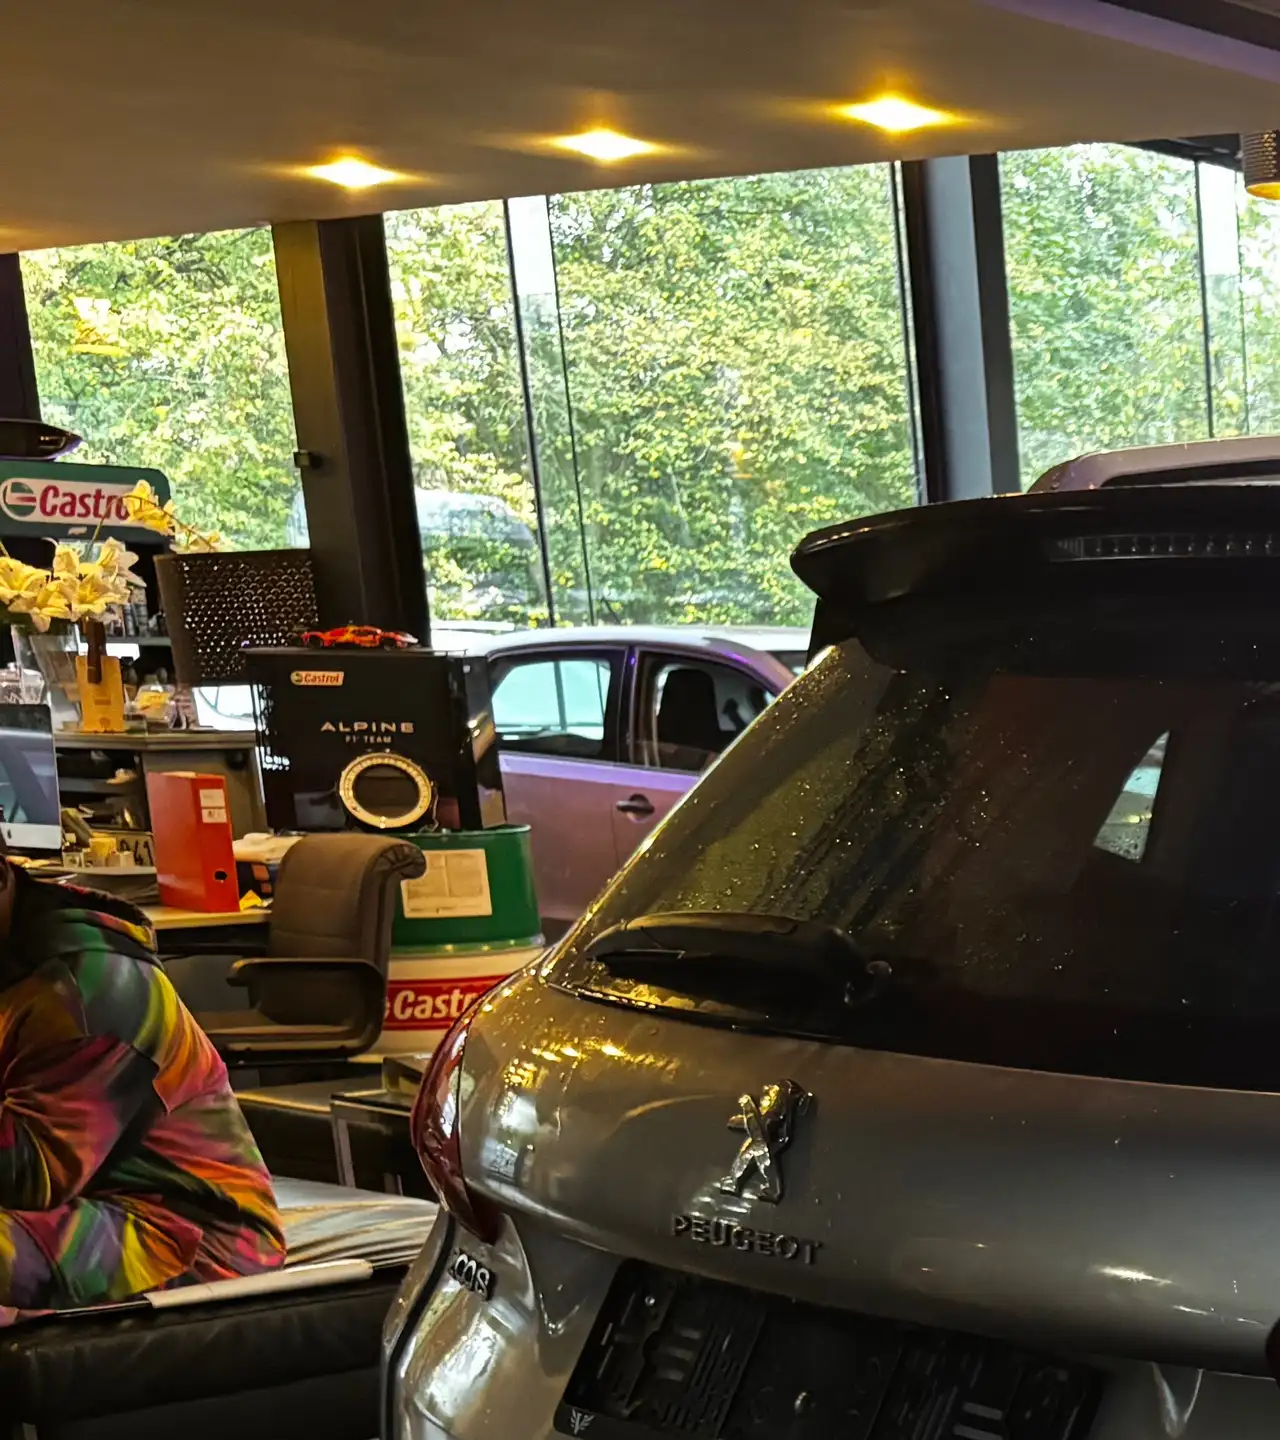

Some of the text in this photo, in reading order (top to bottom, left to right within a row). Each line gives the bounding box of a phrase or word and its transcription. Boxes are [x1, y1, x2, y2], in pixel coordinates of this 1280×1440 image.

[39, 485, 131, 521] Castro
[304, 673, 340, 685] Castrol
[320, 721, 415, 733] ALPINE
[364, 735, 392, 744] TEAM
[393, 988, 479, 1020] Castr
[672, 1215, 824, 1265] PEUGEOT
